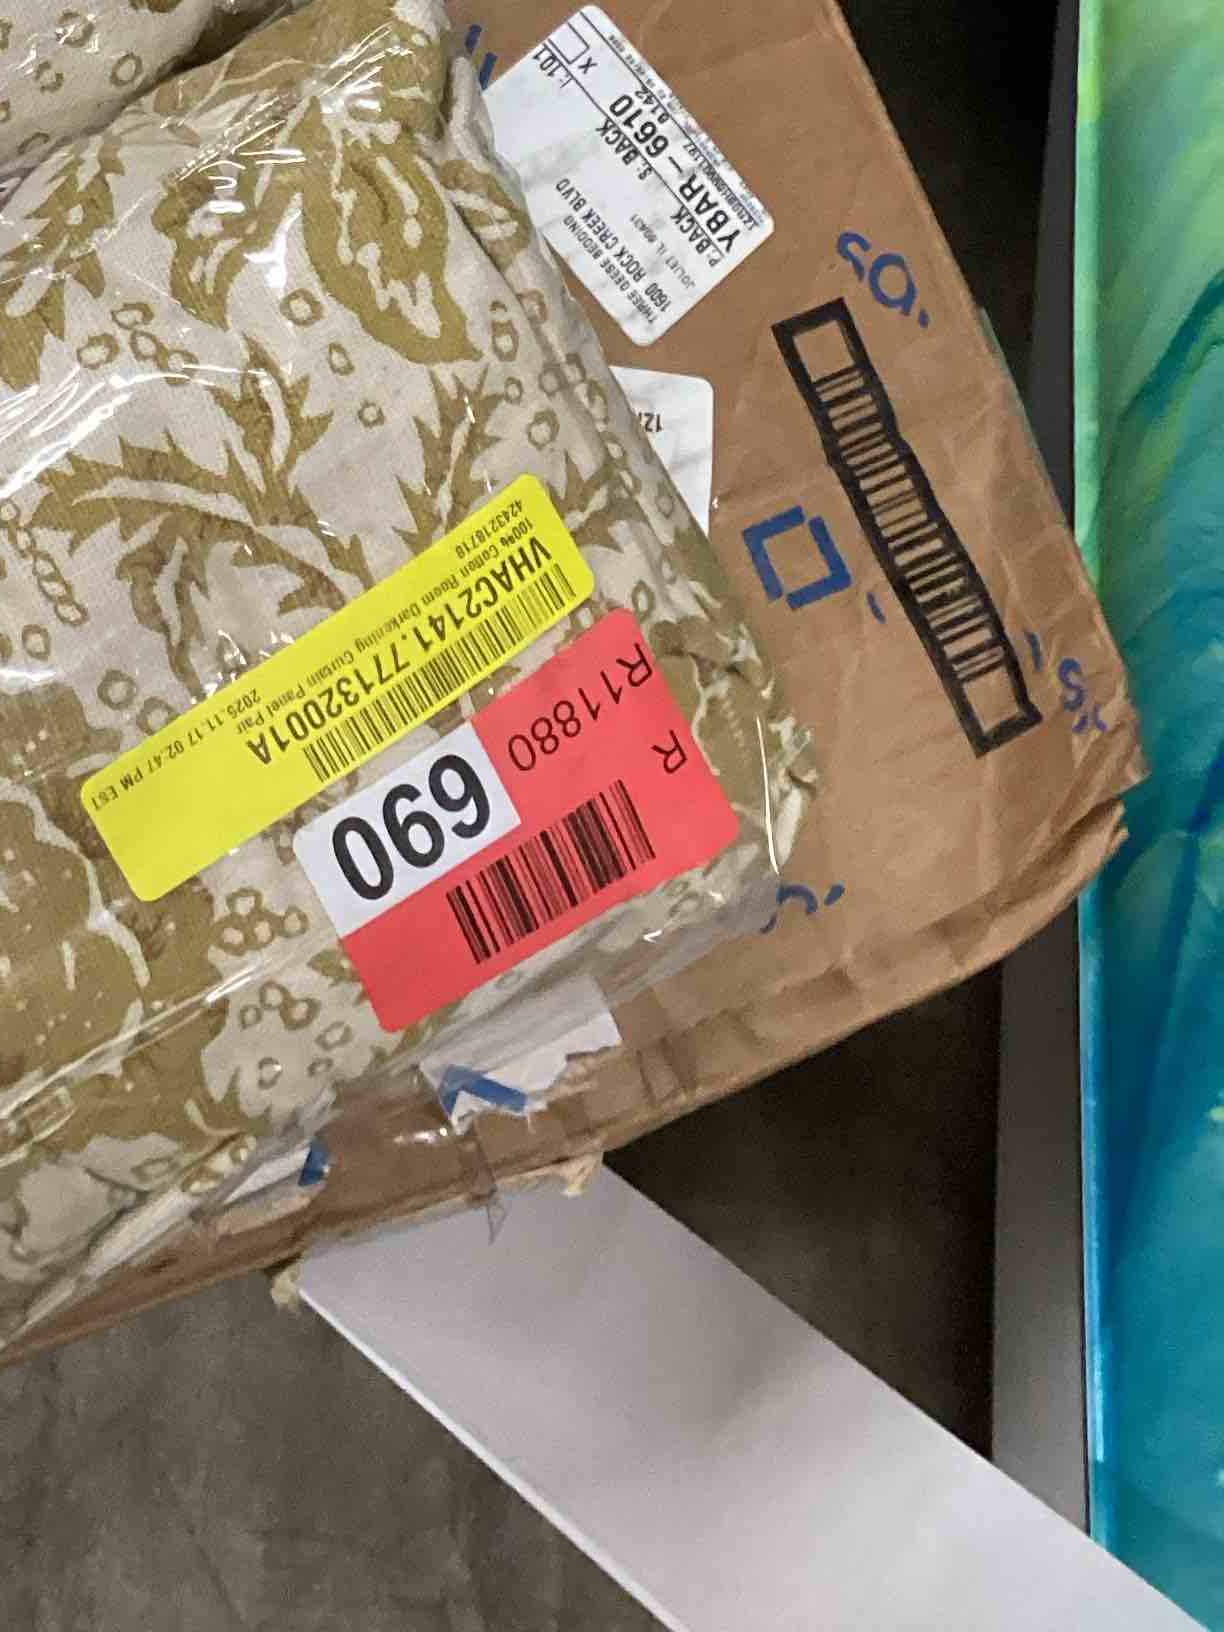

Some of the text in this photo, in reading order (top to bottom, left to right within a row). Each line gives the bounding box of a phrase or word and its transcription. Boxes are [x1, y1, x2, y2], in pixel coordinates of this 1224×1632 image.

[578, 57, 596, 74] X
[595, 118, 638, 164] BACK
[609, 92, 669, 158] 6610
[555, 177, 672, 312] 1600 ROCK CREEK BLVD
[670, 207, 711, 252] BACK
[677, 175, 744, 250] YBAR
[454, 500, 524, 558] 4243218718
[232, 517, 533, 739] 100% Cotton Room Darkening Curtain Panel Pair
[247, 538, 551, 765] VHAC2141.77132001A
[508, 643, 655, 771] R11880
[118, 767, 143, 789] PM
[649, 731, 690, 775] R
[331, 755, 491, 901] 690
